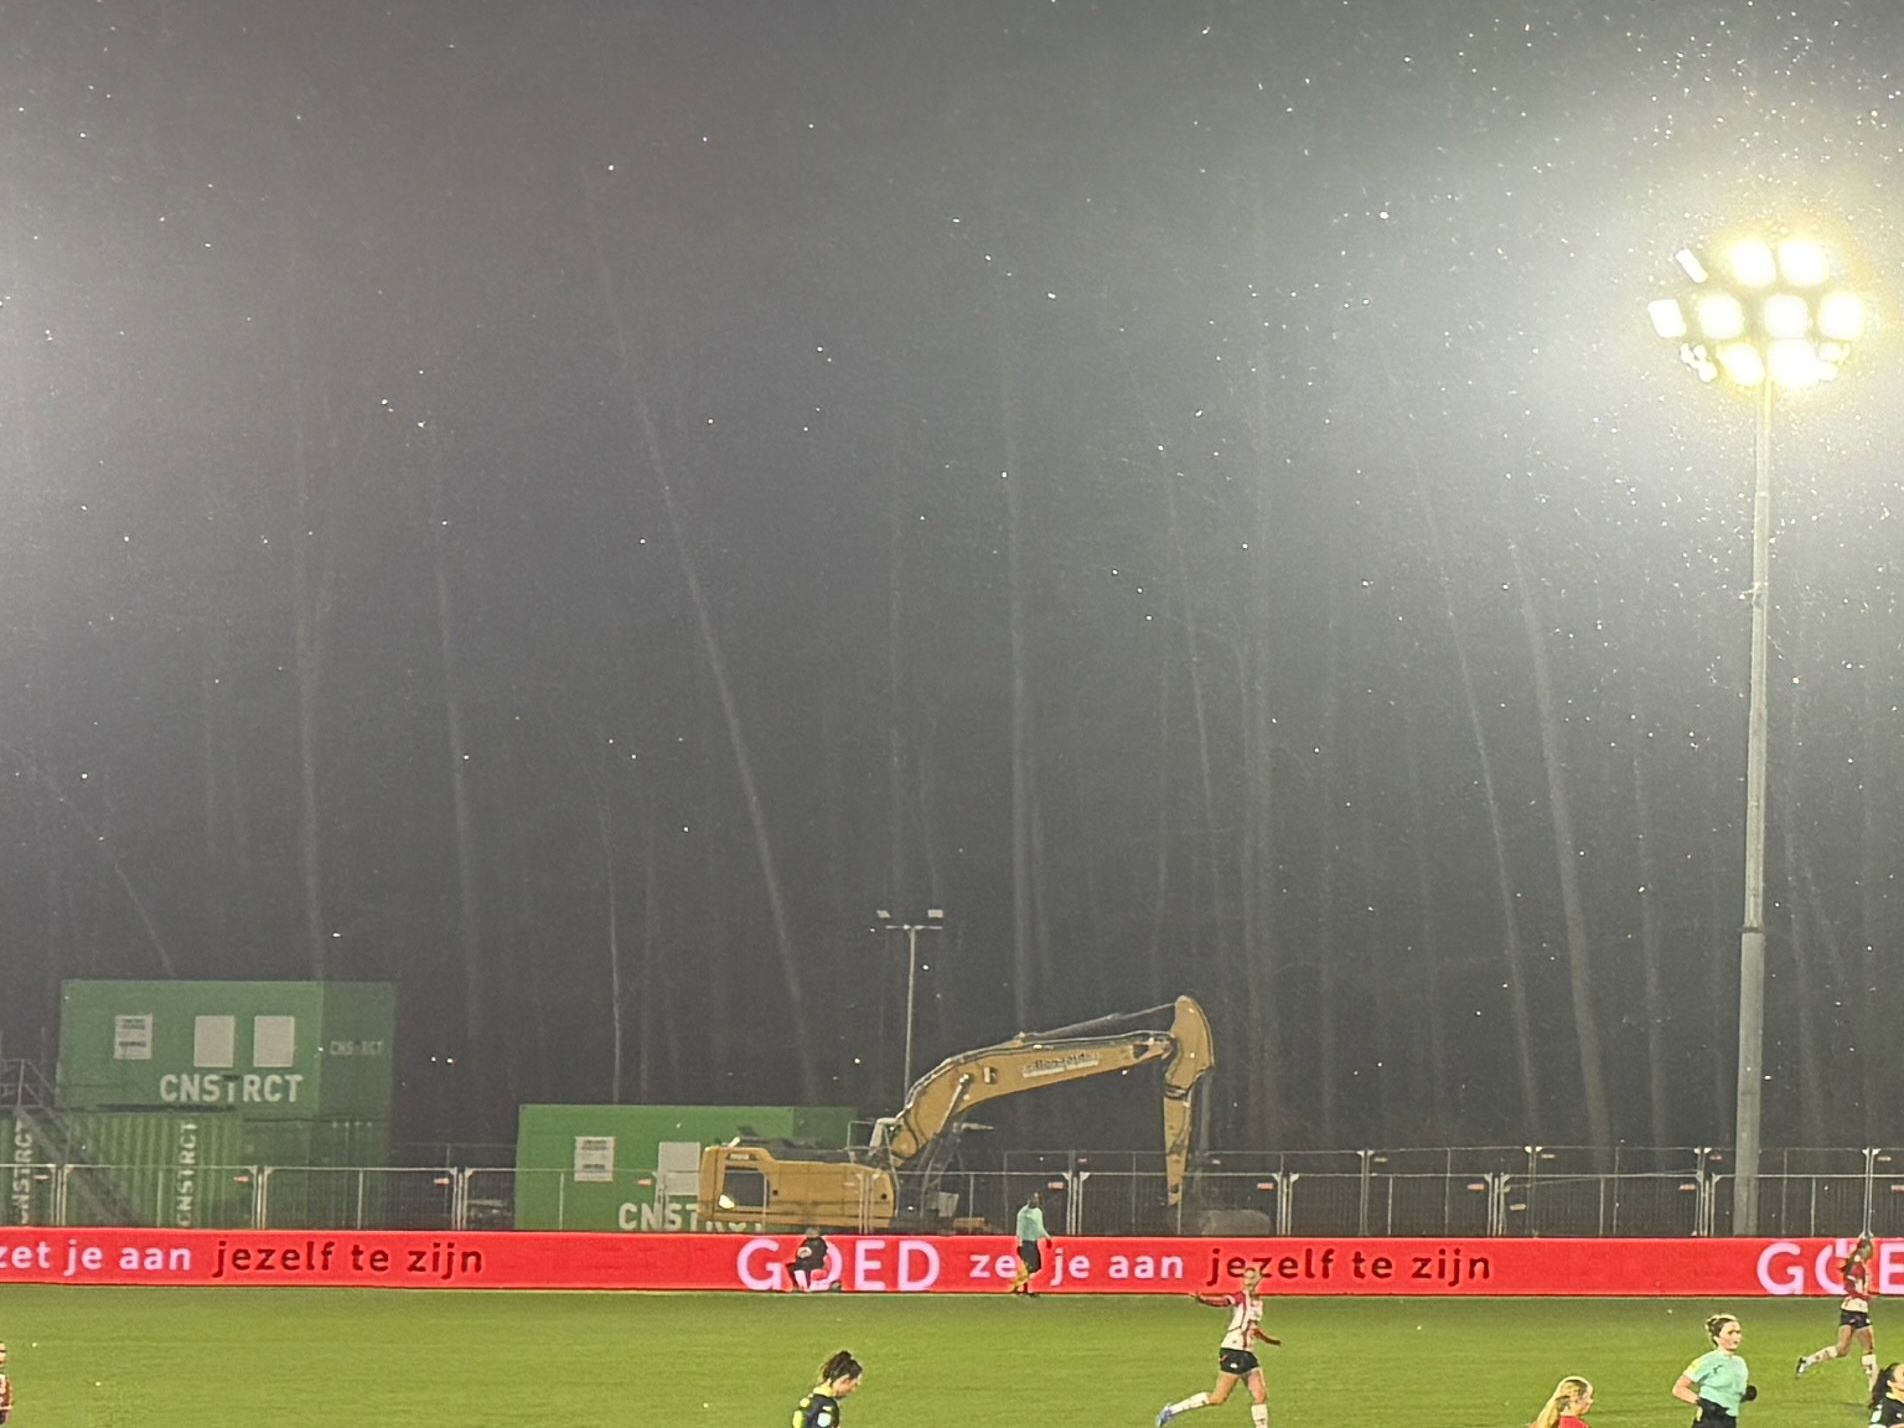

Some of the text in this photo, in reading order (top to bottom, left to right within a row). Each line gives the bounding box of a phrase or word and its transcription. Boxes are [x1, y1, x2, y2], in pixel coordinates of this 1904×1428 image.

[160, 1074, 303, 1102] CNSTRCT
[63, 1239, 103, 1277] je
[119, 1247, 191, 1270] aan
[212, 1240, 335, 1278] jezelf
[351, 1244, 389, 1272] te
[407, 1242, 482, 1280] zijn
[966, 1252, 1018, 1280] ze
[1050, 1248, 1090, 1286] je
[1109, 1255, 1183, 1279] aan
[1206, 1248, 1335, 1287] jezelf
[1352, 1251, 1393, 1279] te
[1411, 1248, 1490, 1287] zijn
